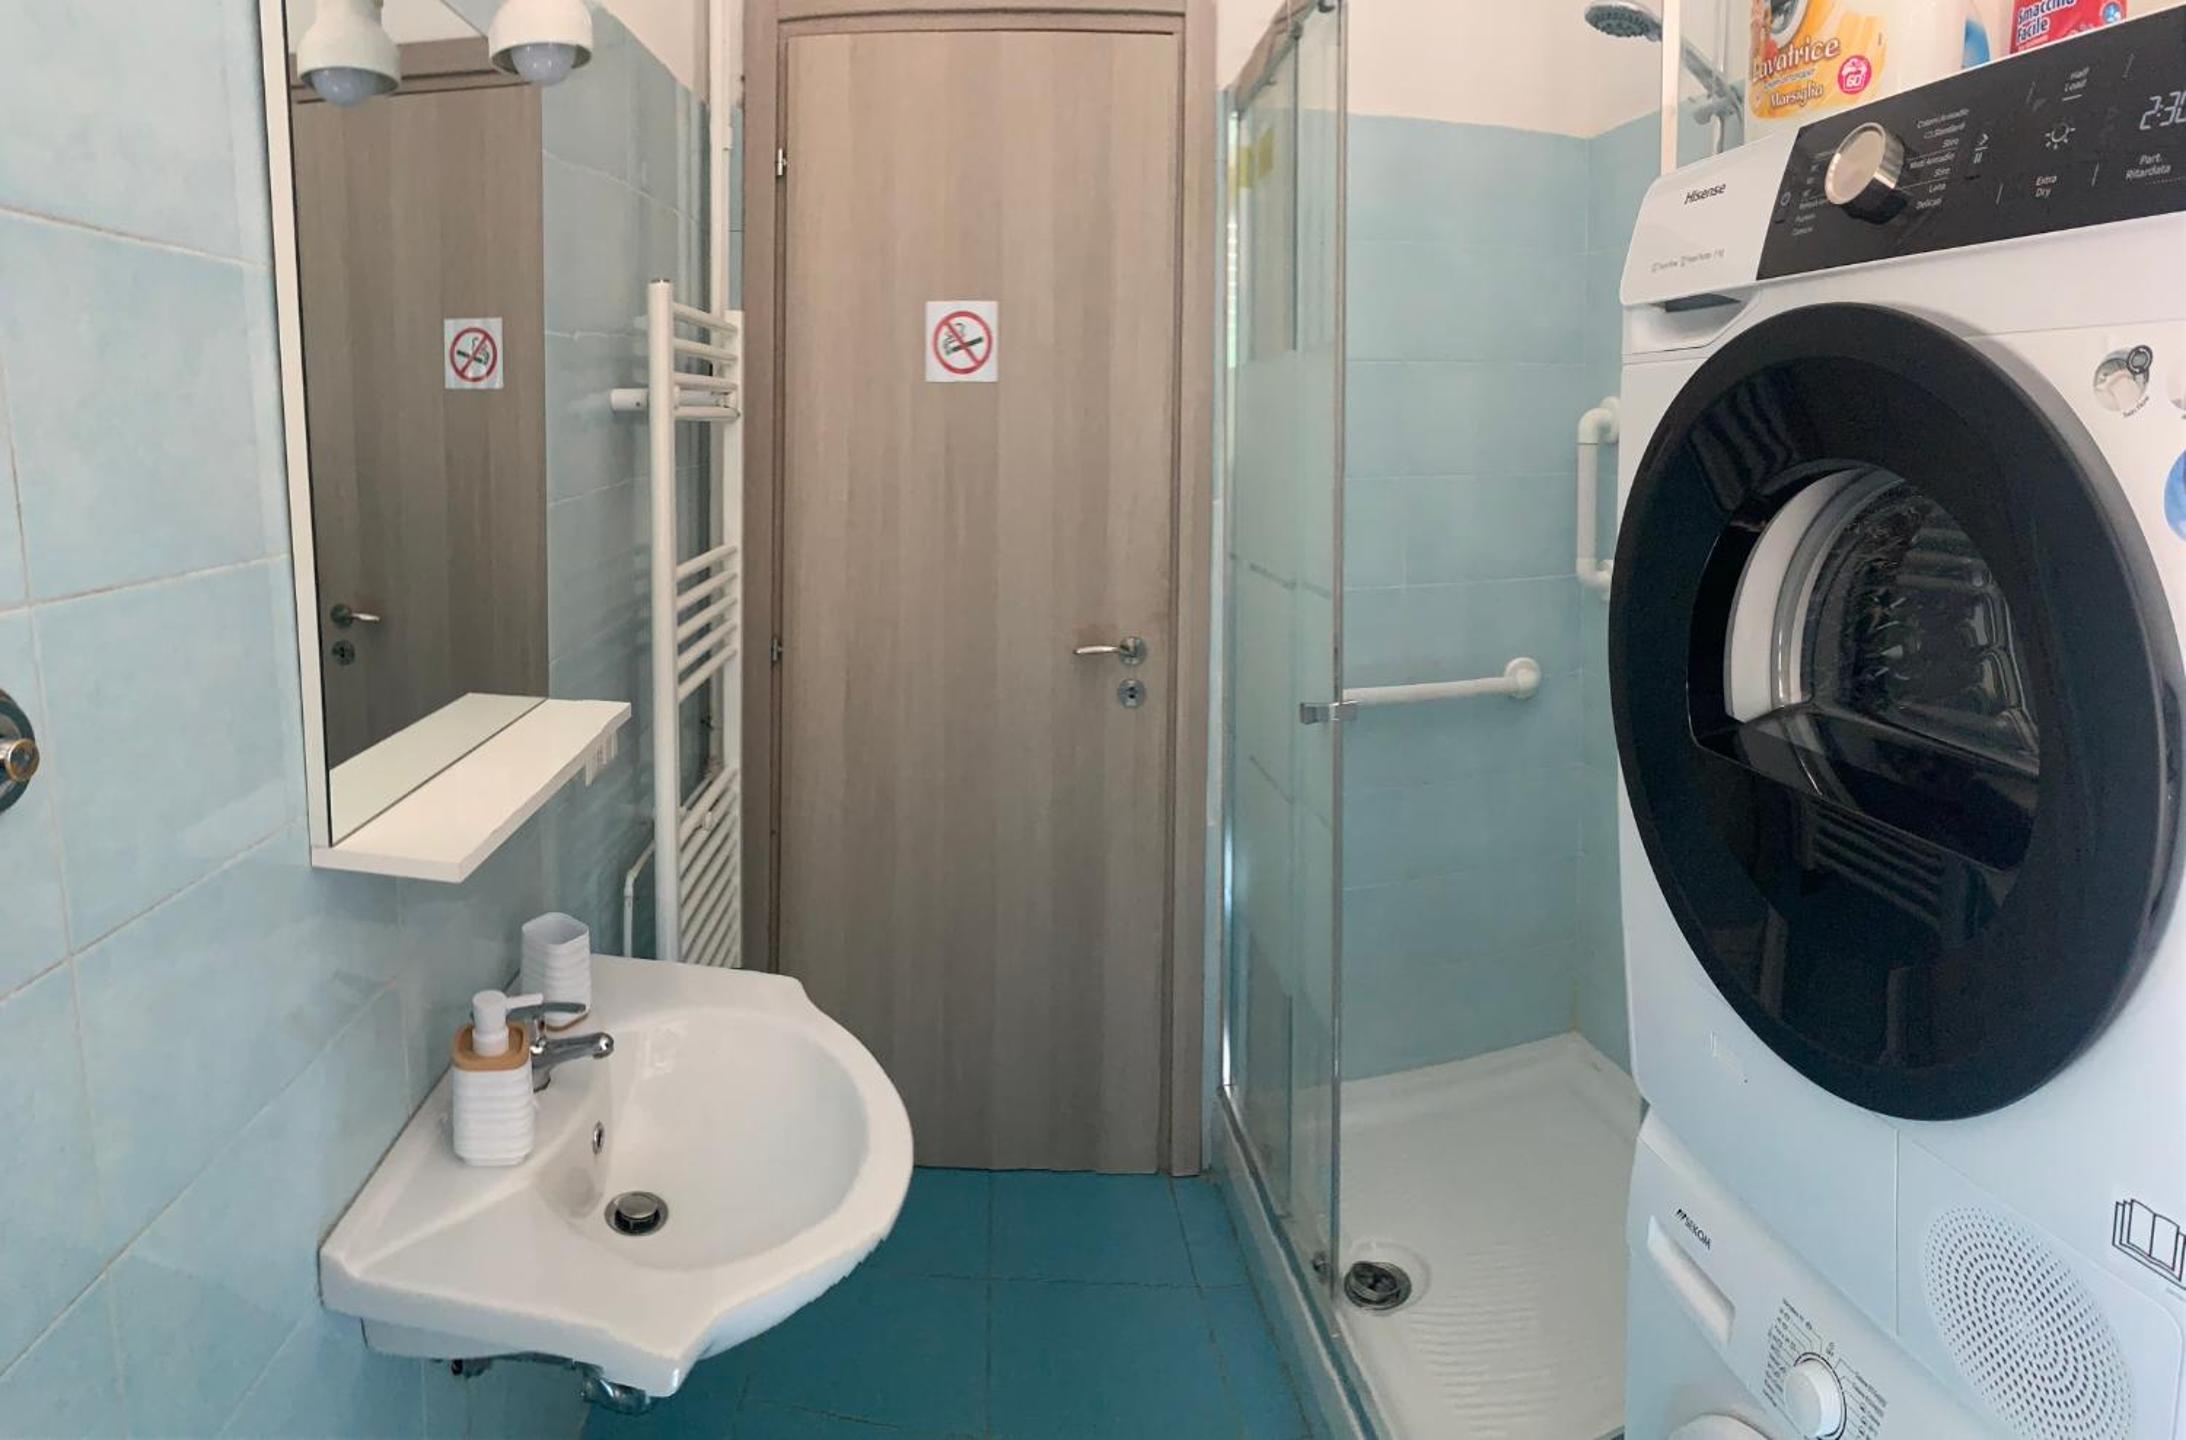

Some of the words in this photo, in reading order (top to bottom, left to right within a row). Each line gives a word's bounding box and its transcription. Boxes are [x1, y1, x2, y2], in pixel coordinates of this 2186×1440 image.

[2017, 17, 2049, 41] Facile
[1752, 37, 1840, 82] Lavatrice
[1771, 82, 1824, 107] Marsiglia
[2035, 175, 2057, 186] Extra
[1684, 183, 1726, 205] Hisense
[2035, 187, 2051, 198] Dry
